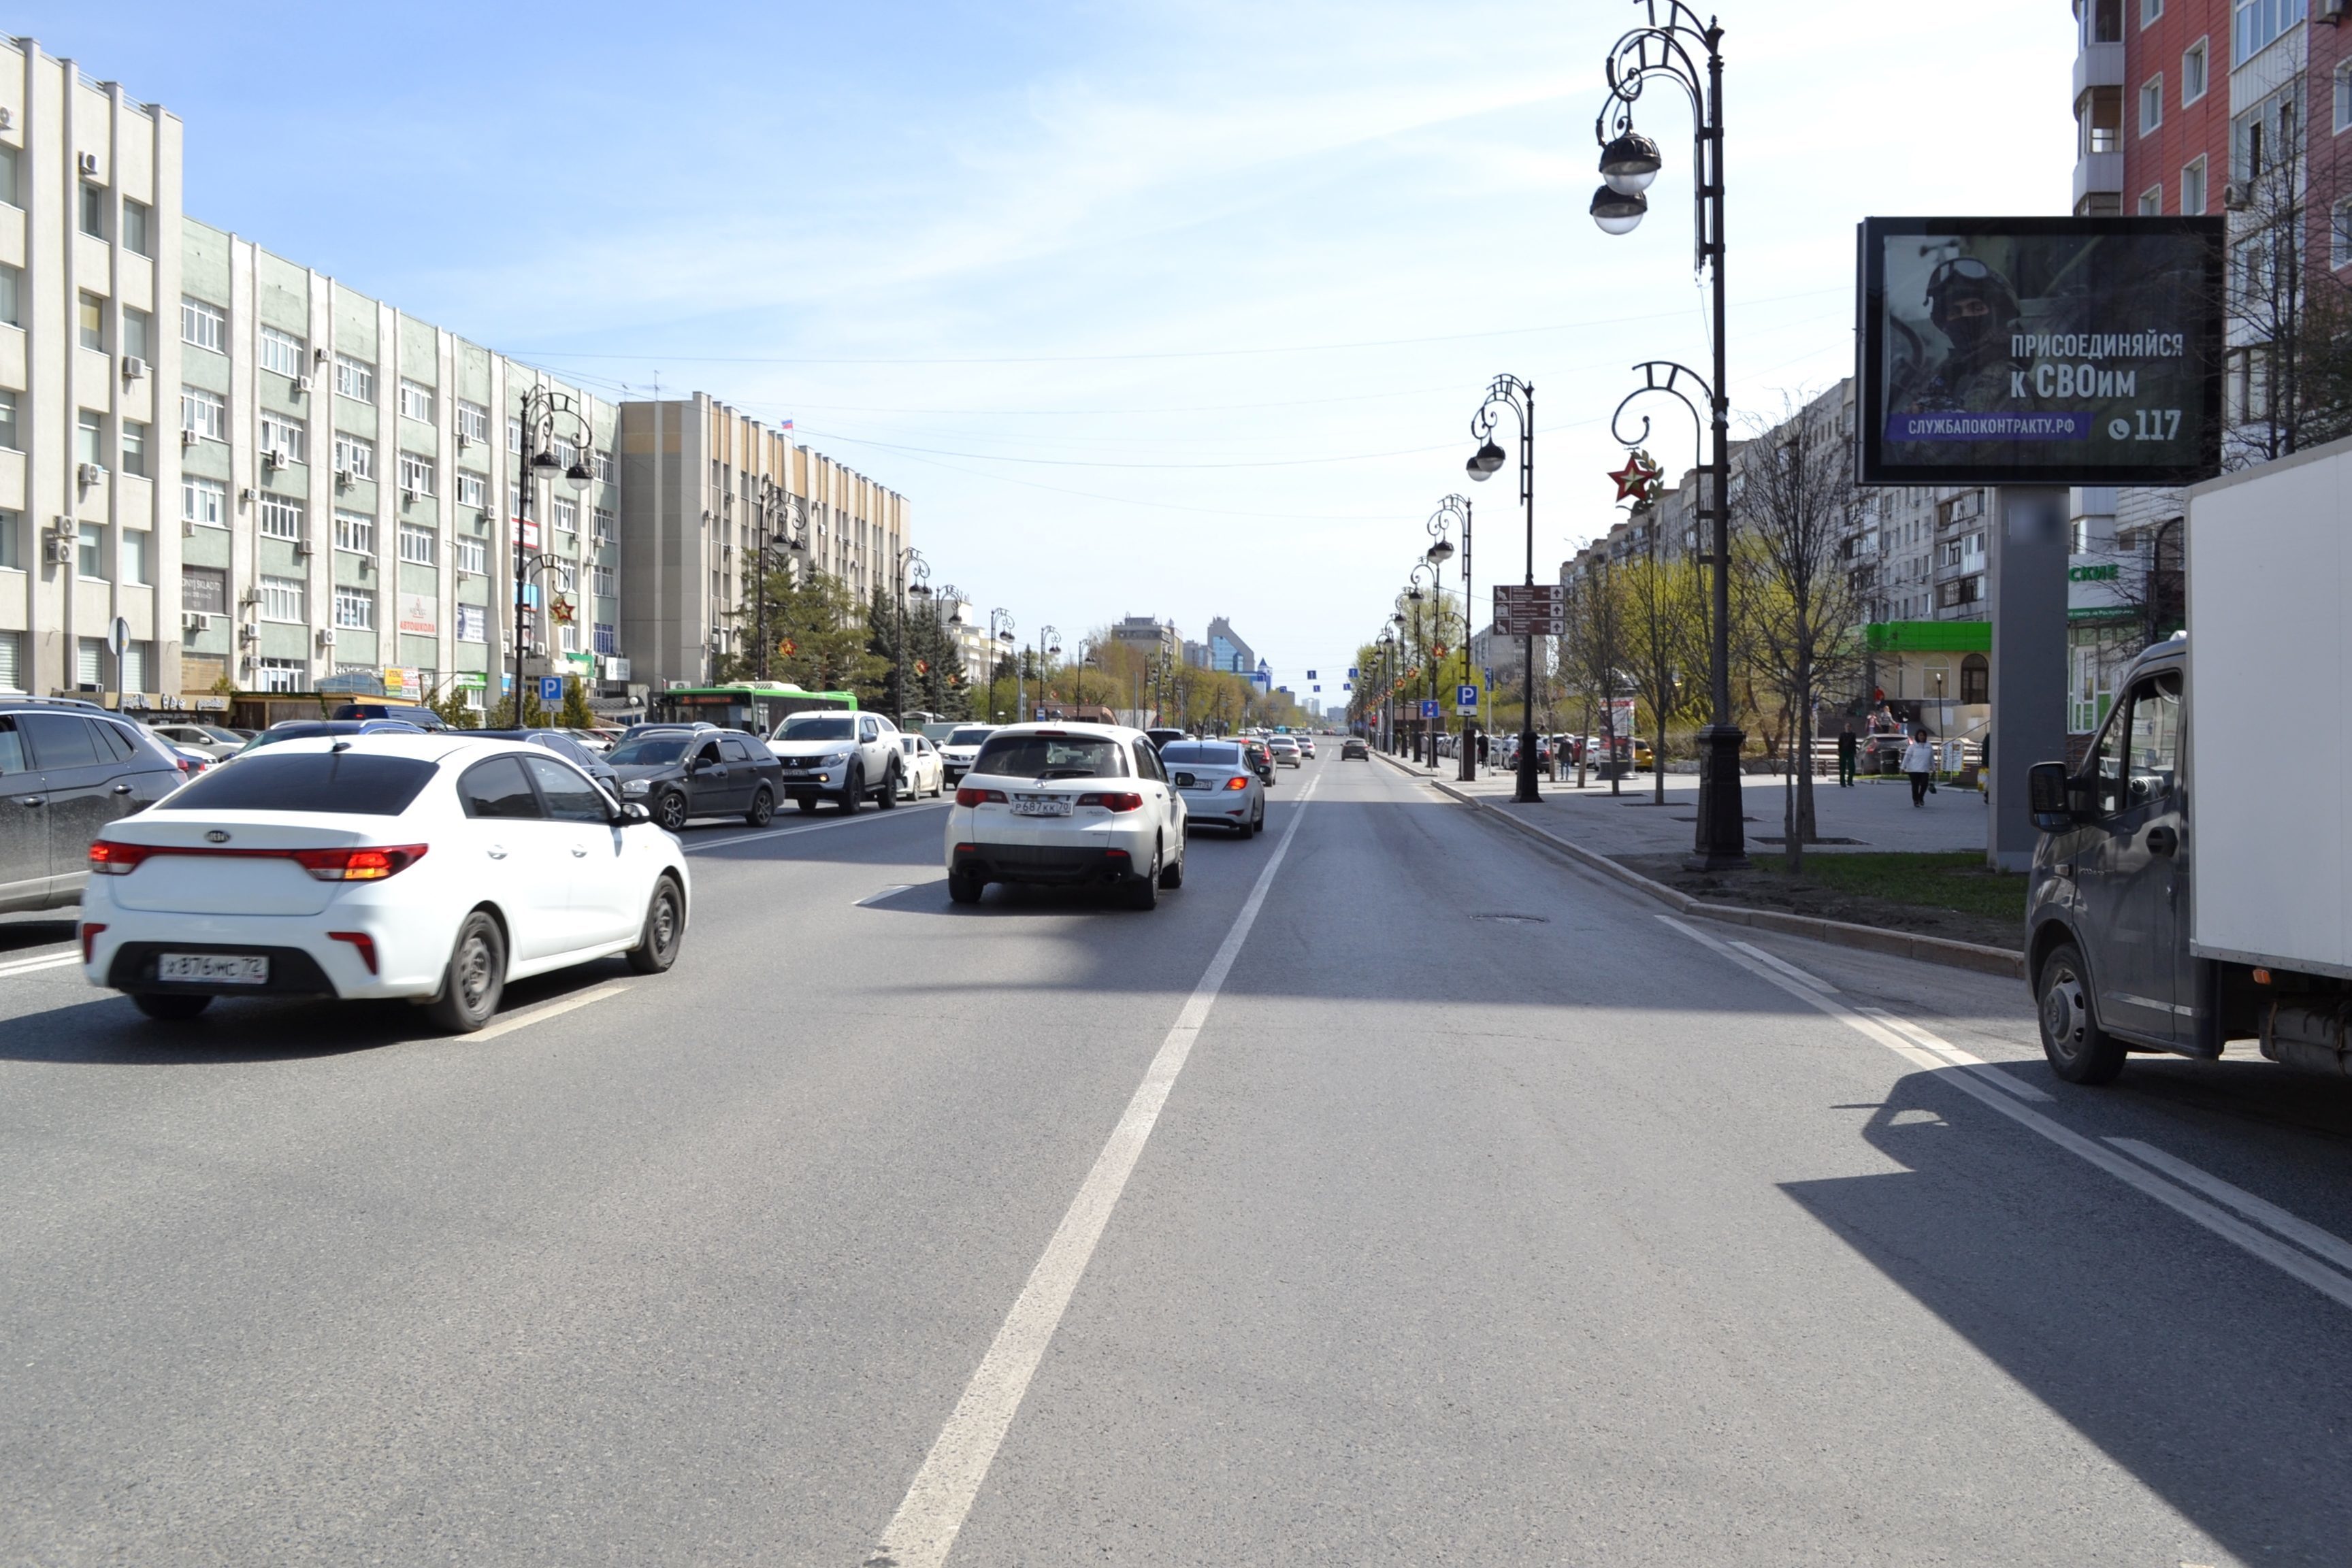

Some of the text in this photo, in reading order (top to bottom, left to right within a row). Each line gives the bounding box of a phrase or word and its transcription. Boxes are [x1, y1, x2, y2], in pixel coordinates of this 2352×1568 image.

[2012, 329, 2183, 359] ПРИСОЕДИНЯЙСЯ
[1908, 419, 2075, 435] СЛУЖБАПОКОНТРАКТУ.РФ
[2134, 410, 2181, 441] 117
[399, 620, 436, 633] АВТОШКОЛА
[545, 679, 557, 698] P
[1463, 687, 1474, 704] P
